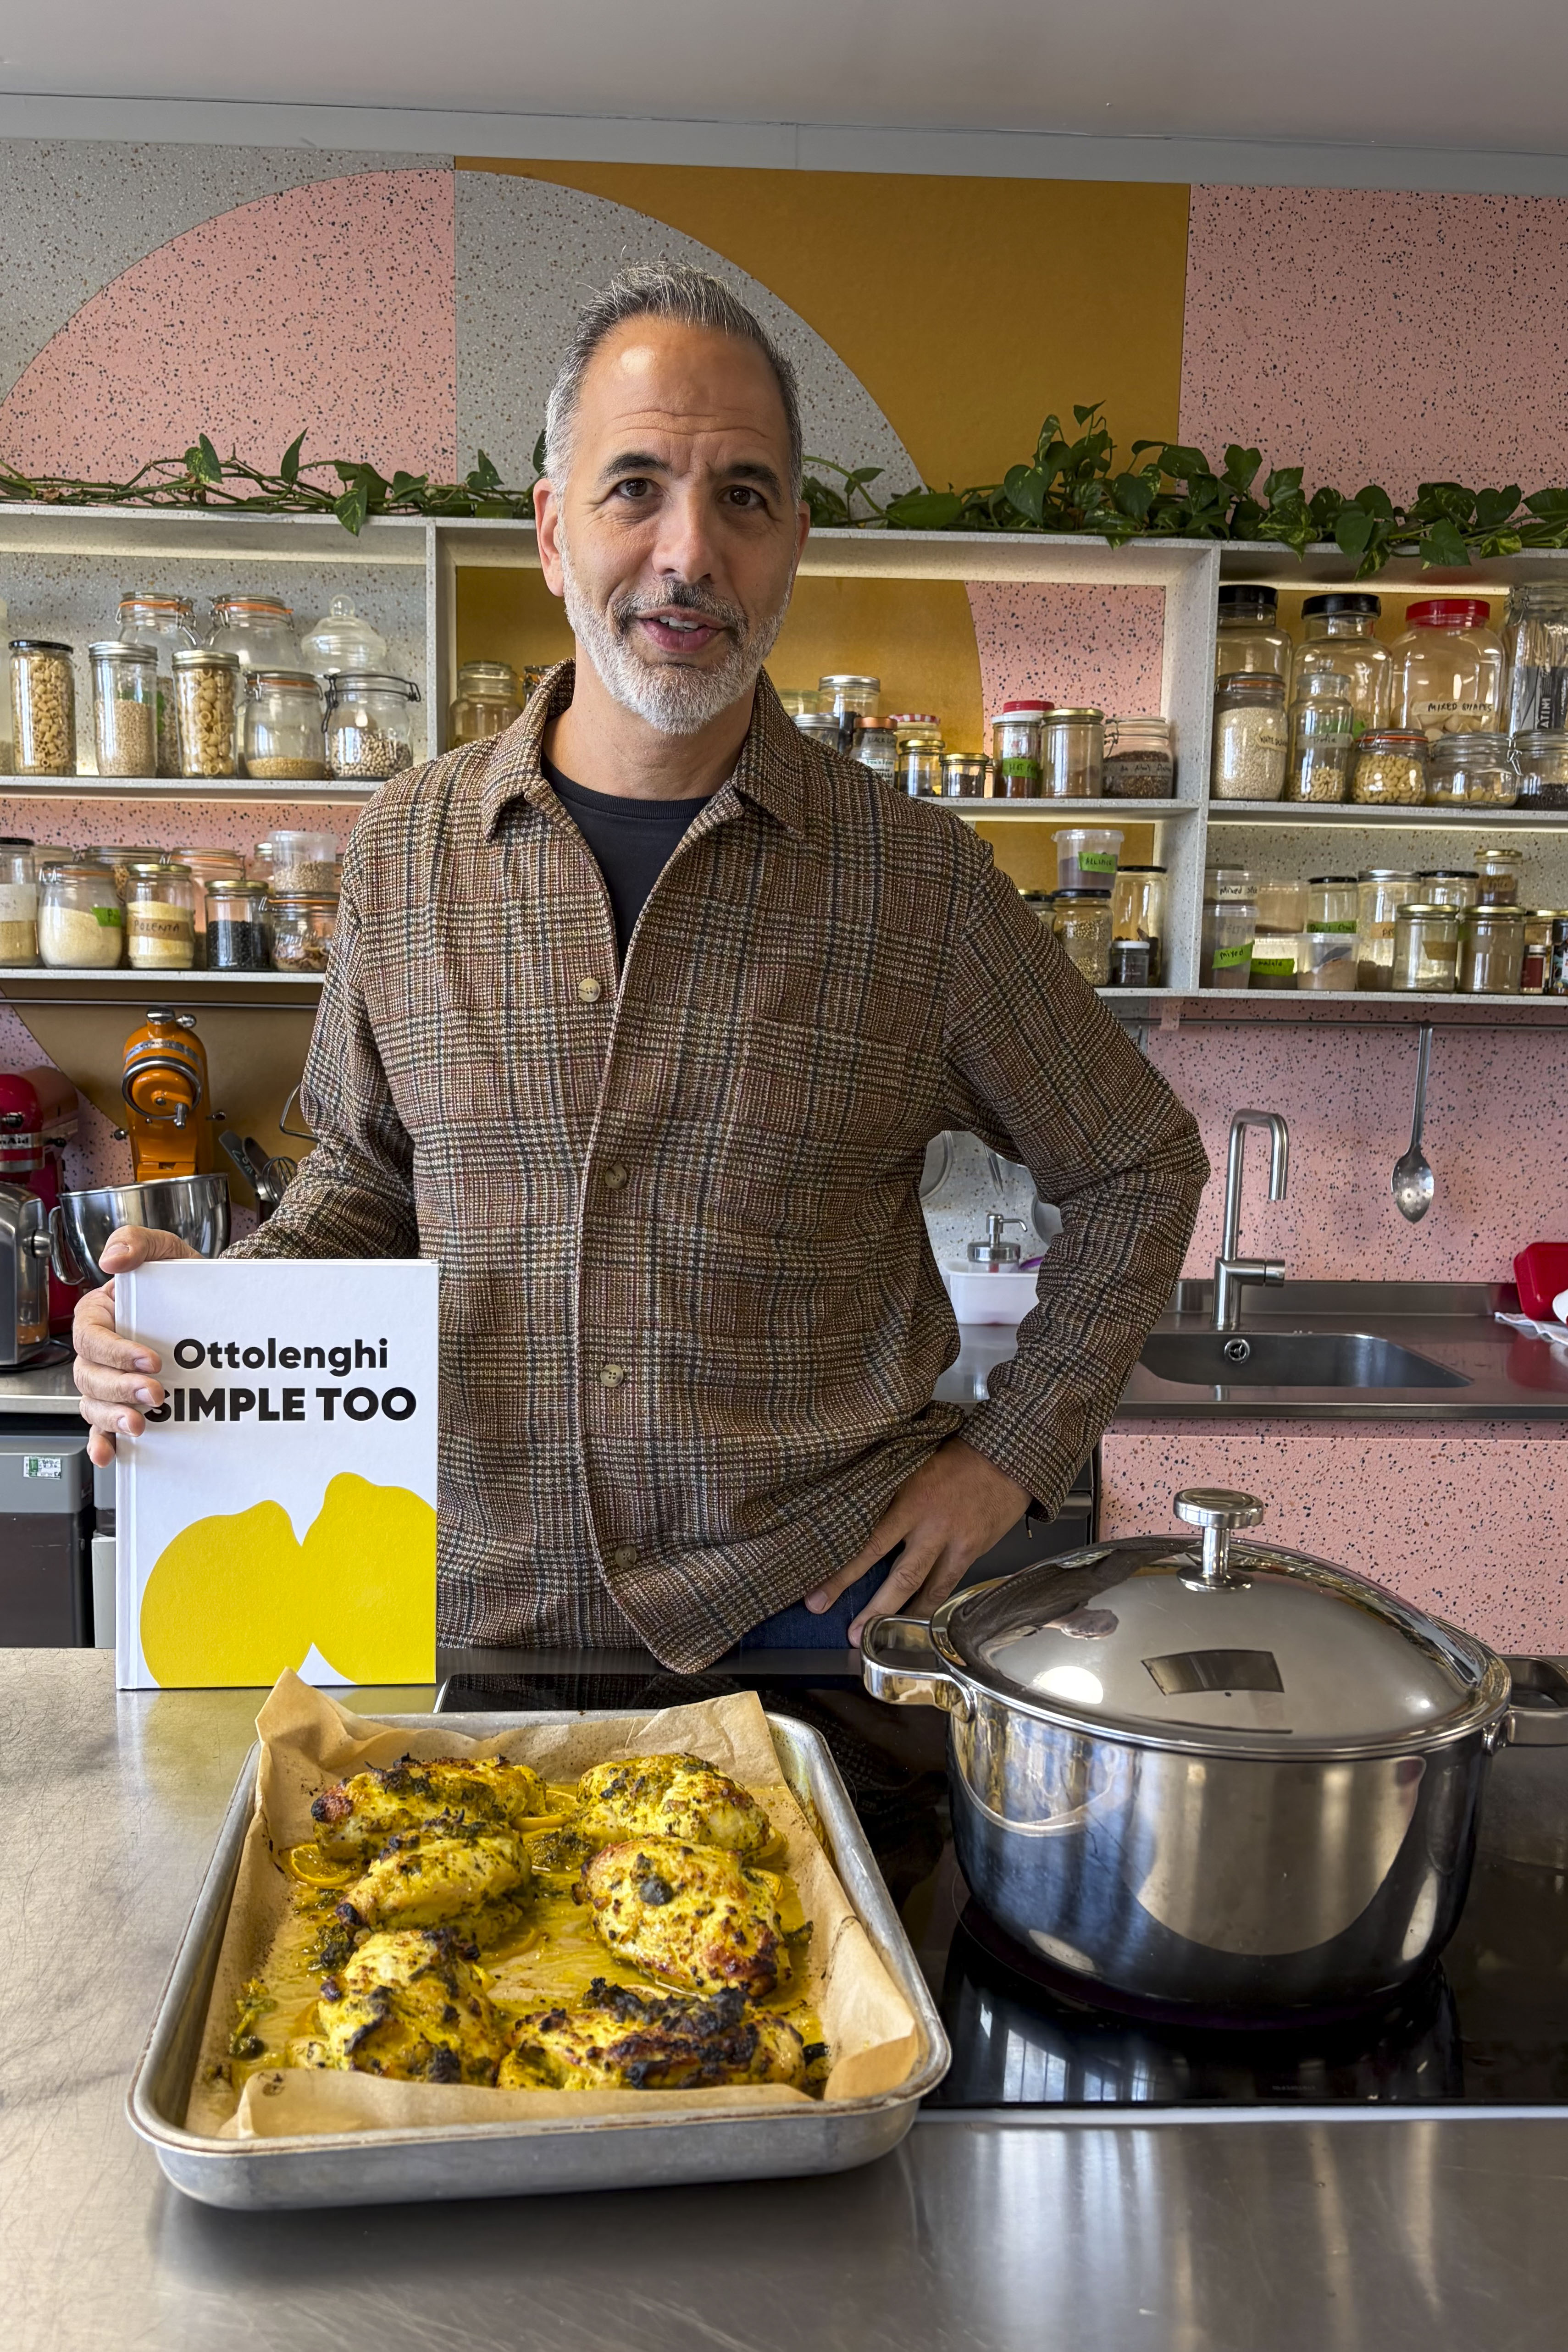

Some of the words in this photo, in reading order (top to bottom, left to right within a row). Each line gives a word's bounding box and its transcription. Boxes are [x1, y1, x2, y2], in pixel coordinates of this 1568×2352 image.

[1428, 703, 1457, 712] MIXED
[1462, 703, 1492, 712] SHAPES
[133, 919, 180, 934] POLENTA
[174, 1337, 388, 1377] Ottolenghi
[144, 1387, 305, 1422] SIMPLE
[316, 1387, 416, 1421] TOO
